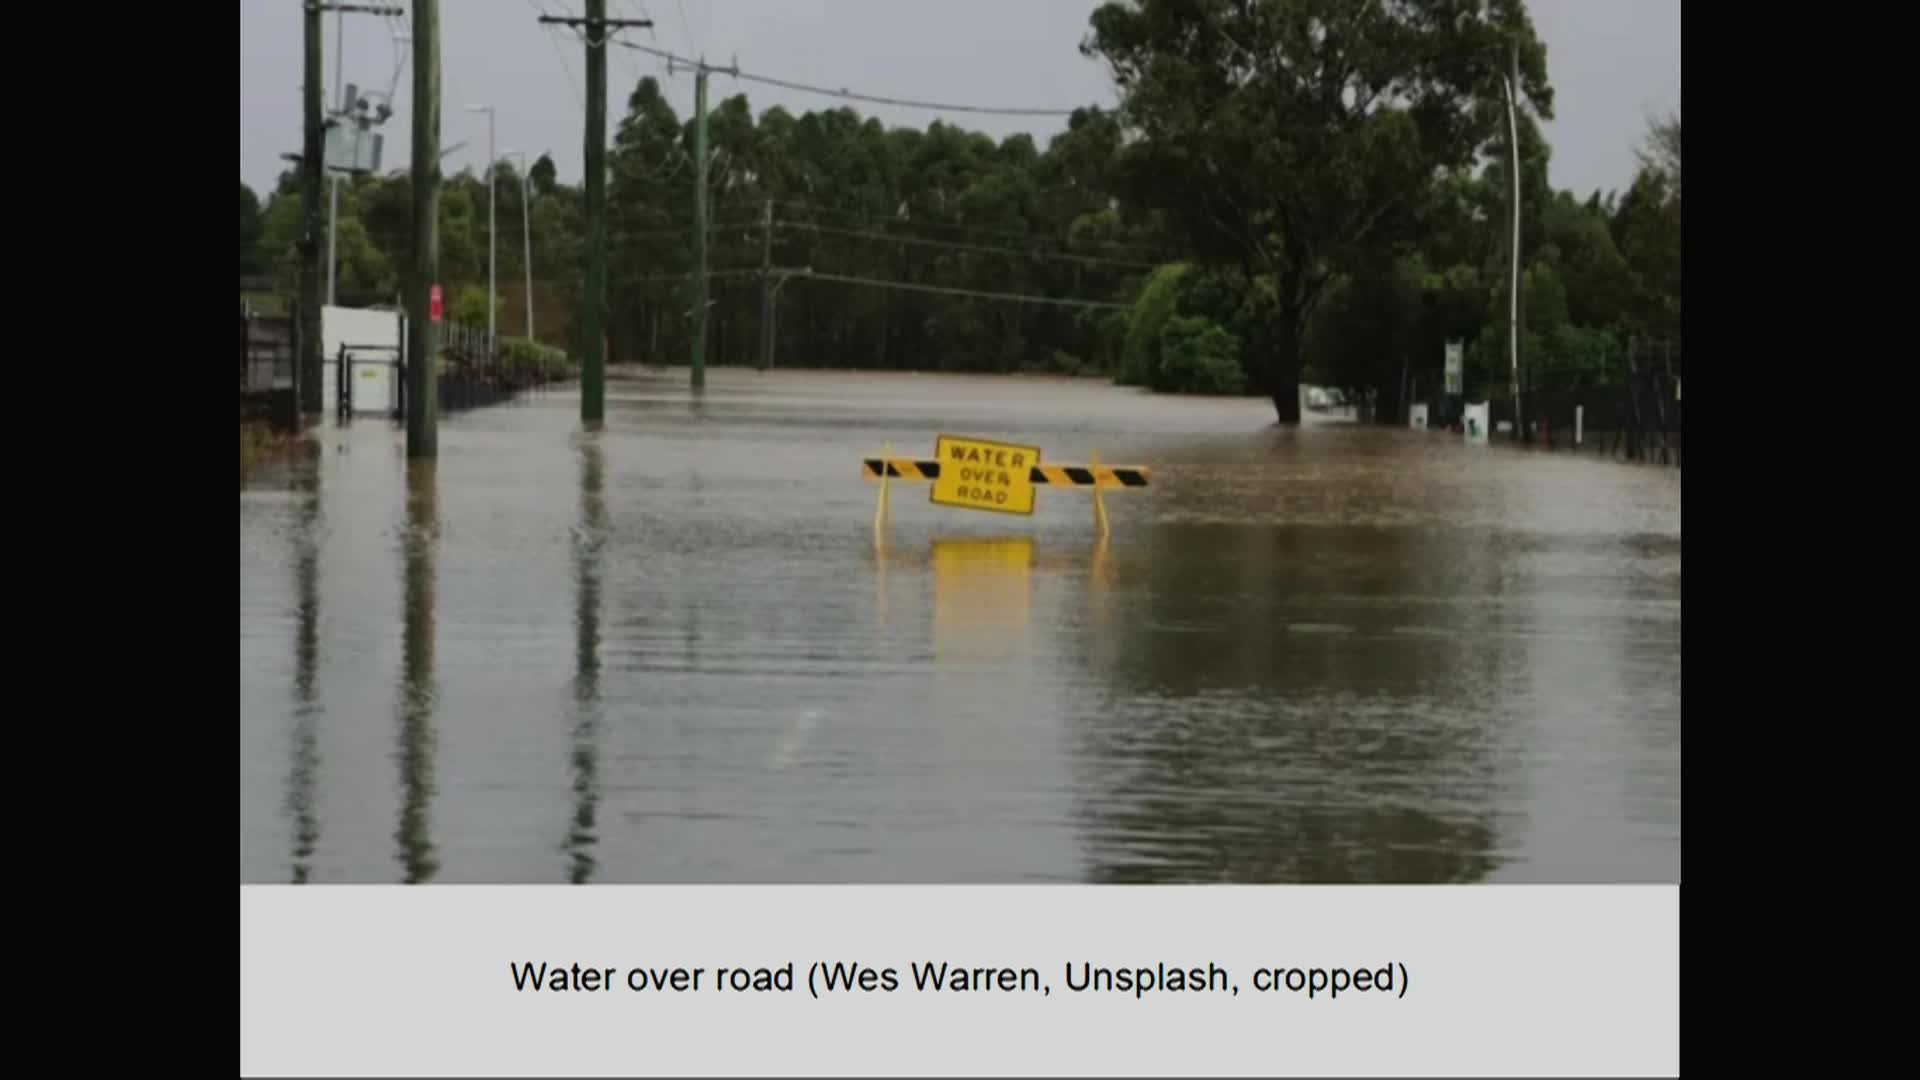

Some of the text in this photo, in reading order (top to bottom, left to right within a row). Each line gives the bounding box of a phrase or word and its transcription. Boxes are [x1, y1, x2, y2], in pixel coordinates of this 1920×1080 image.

[951, 446, 1024, 467] WATER
[961, 467, 1010, 486] OVER
[957, 487, 1008, 504] ROAD
